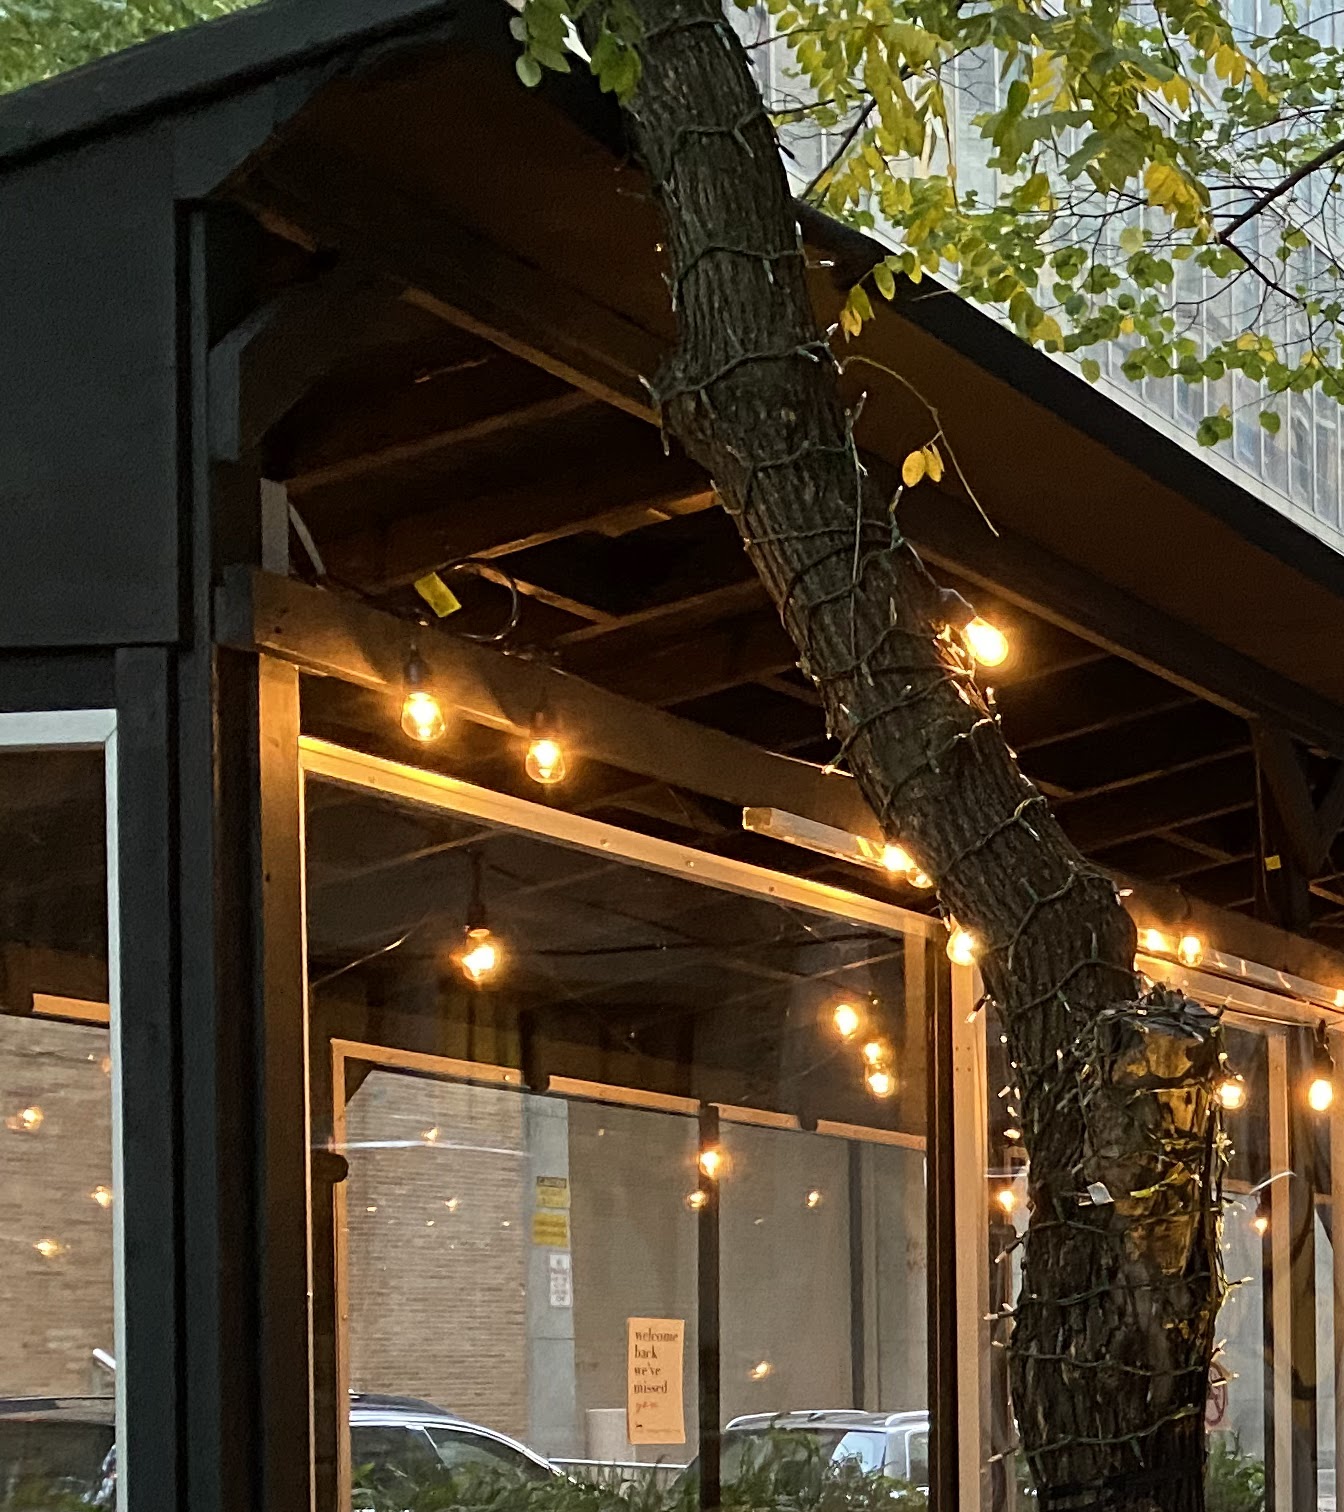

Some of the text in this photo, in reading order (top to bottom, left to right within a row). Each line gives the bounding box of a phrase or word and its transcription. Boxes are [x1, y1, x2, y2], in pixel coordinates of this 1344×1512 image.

[635, 1328, 678, 1342] welcome
[634, 1344, 658, 1359] back
[633, 1380, 668, 1394] missed
